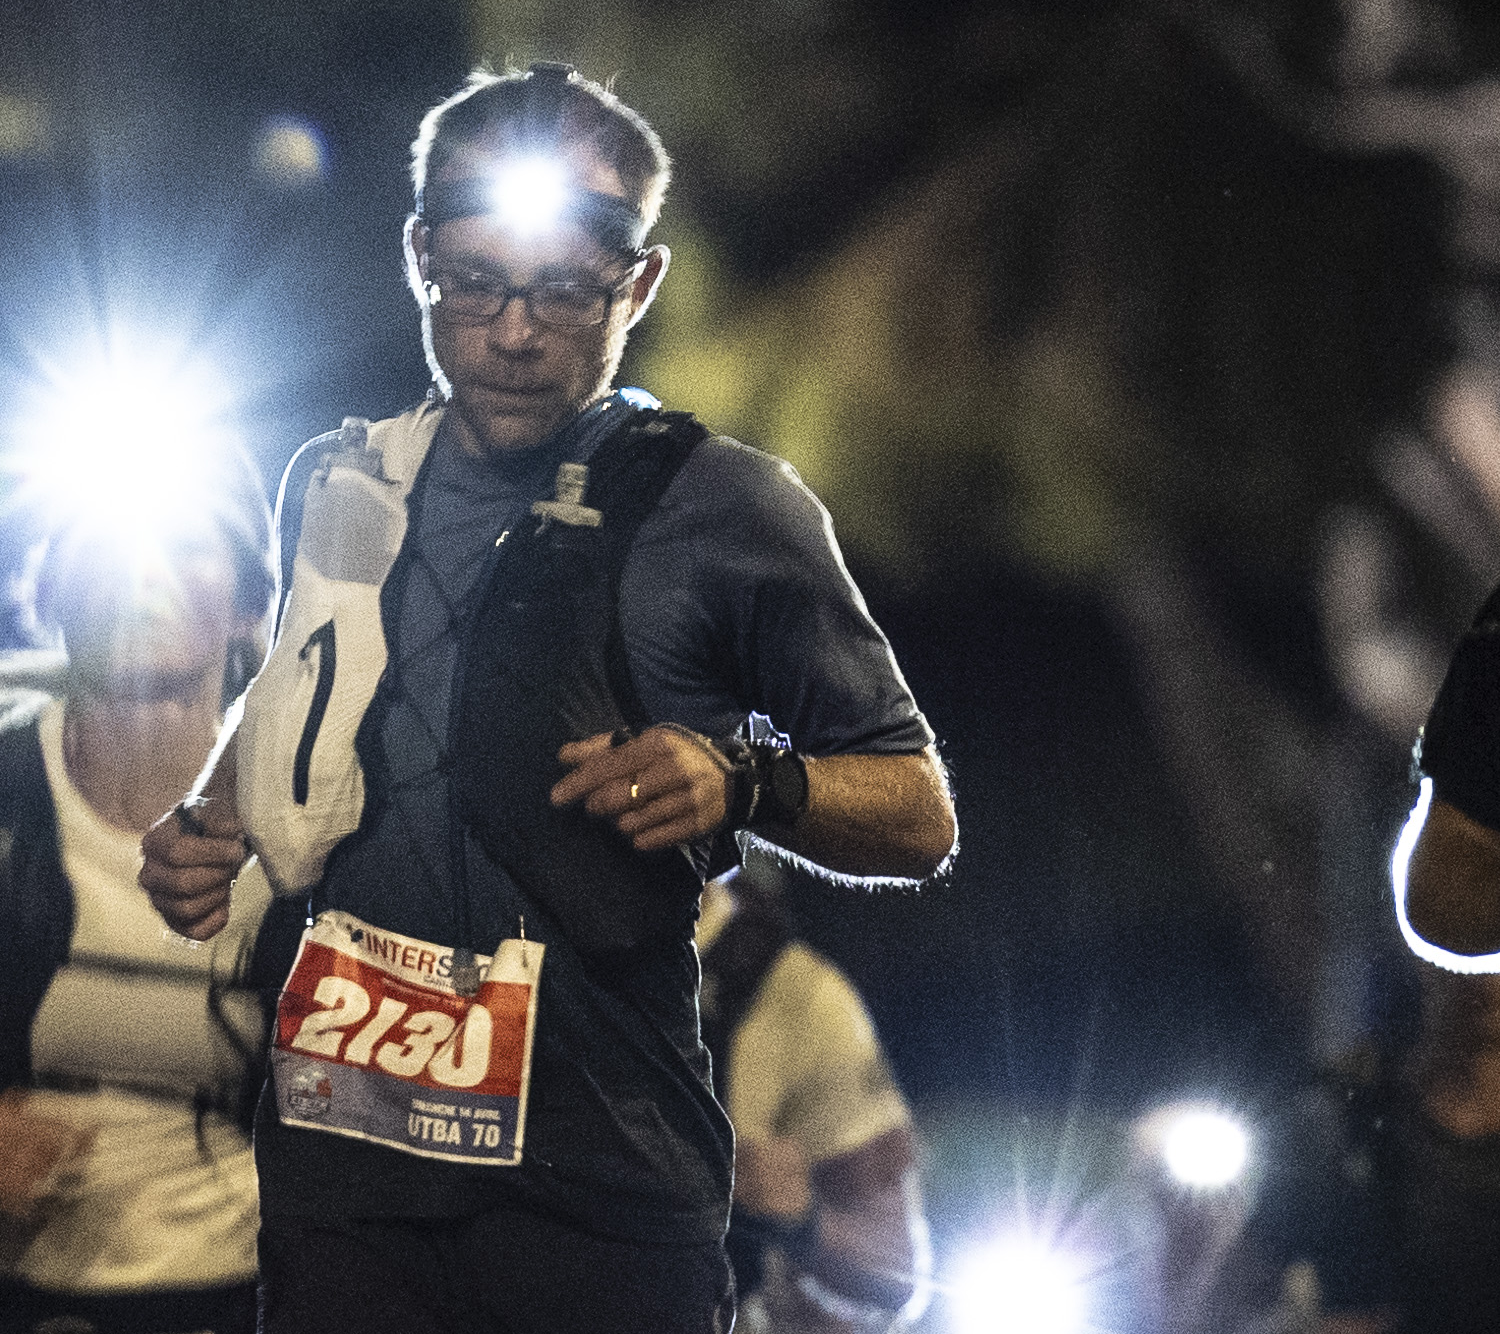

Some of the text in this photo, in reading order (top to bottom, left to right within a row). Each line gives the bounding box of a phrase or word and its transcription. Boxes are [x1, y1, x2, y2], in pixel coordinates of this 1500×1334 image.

[292, 976, 492, 1088] 2130
[408, 1113, 501, 1148] UTBA 70
